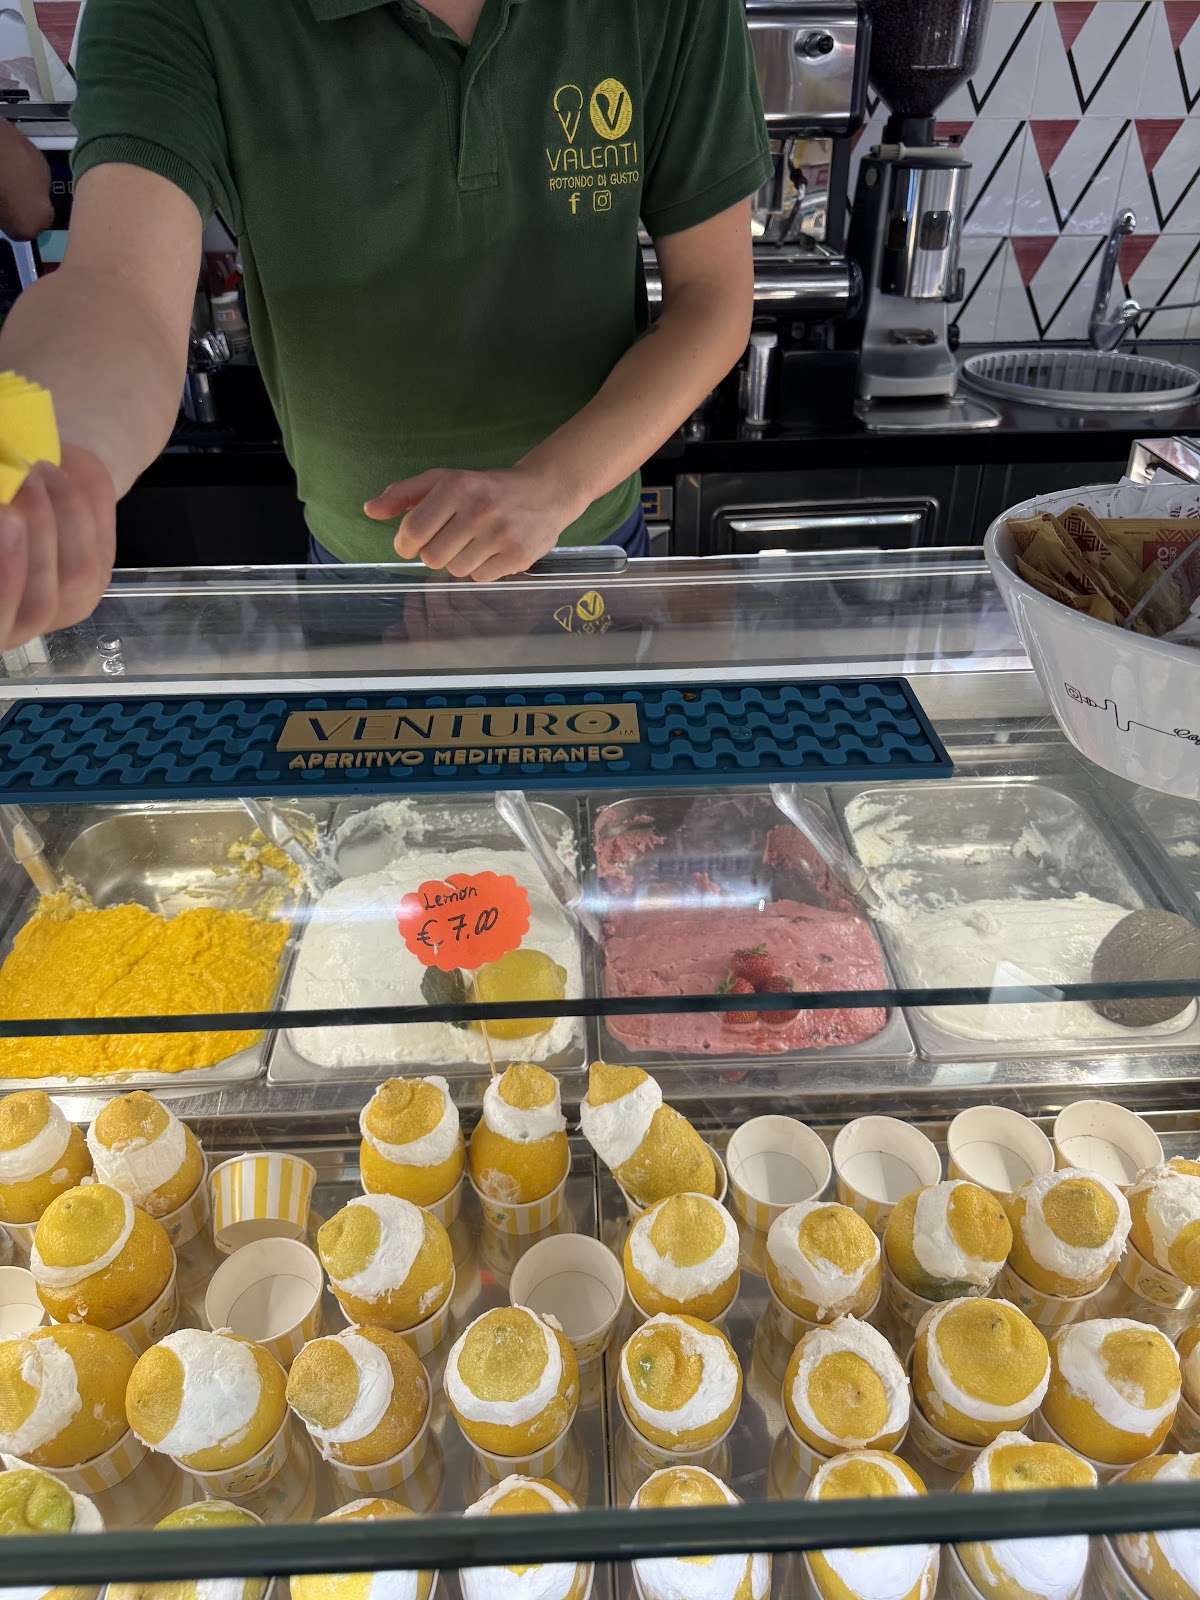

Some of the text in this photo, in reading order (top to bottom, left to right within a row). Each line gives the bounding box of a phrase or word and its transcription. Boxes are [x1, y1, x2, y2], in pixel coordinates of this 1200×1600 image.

[546, 141, 638, 172] VALENTI
[549, 170, 640, 191] ROTONDO DI GUSTO
[308, 709, 621, 741] VENTURO
[288, 745, 624, 770] APERITIVO MEDITERRANEO
[421, 886, 478, 911] Lemon
[416, 907, 499, 947] € 7.00
